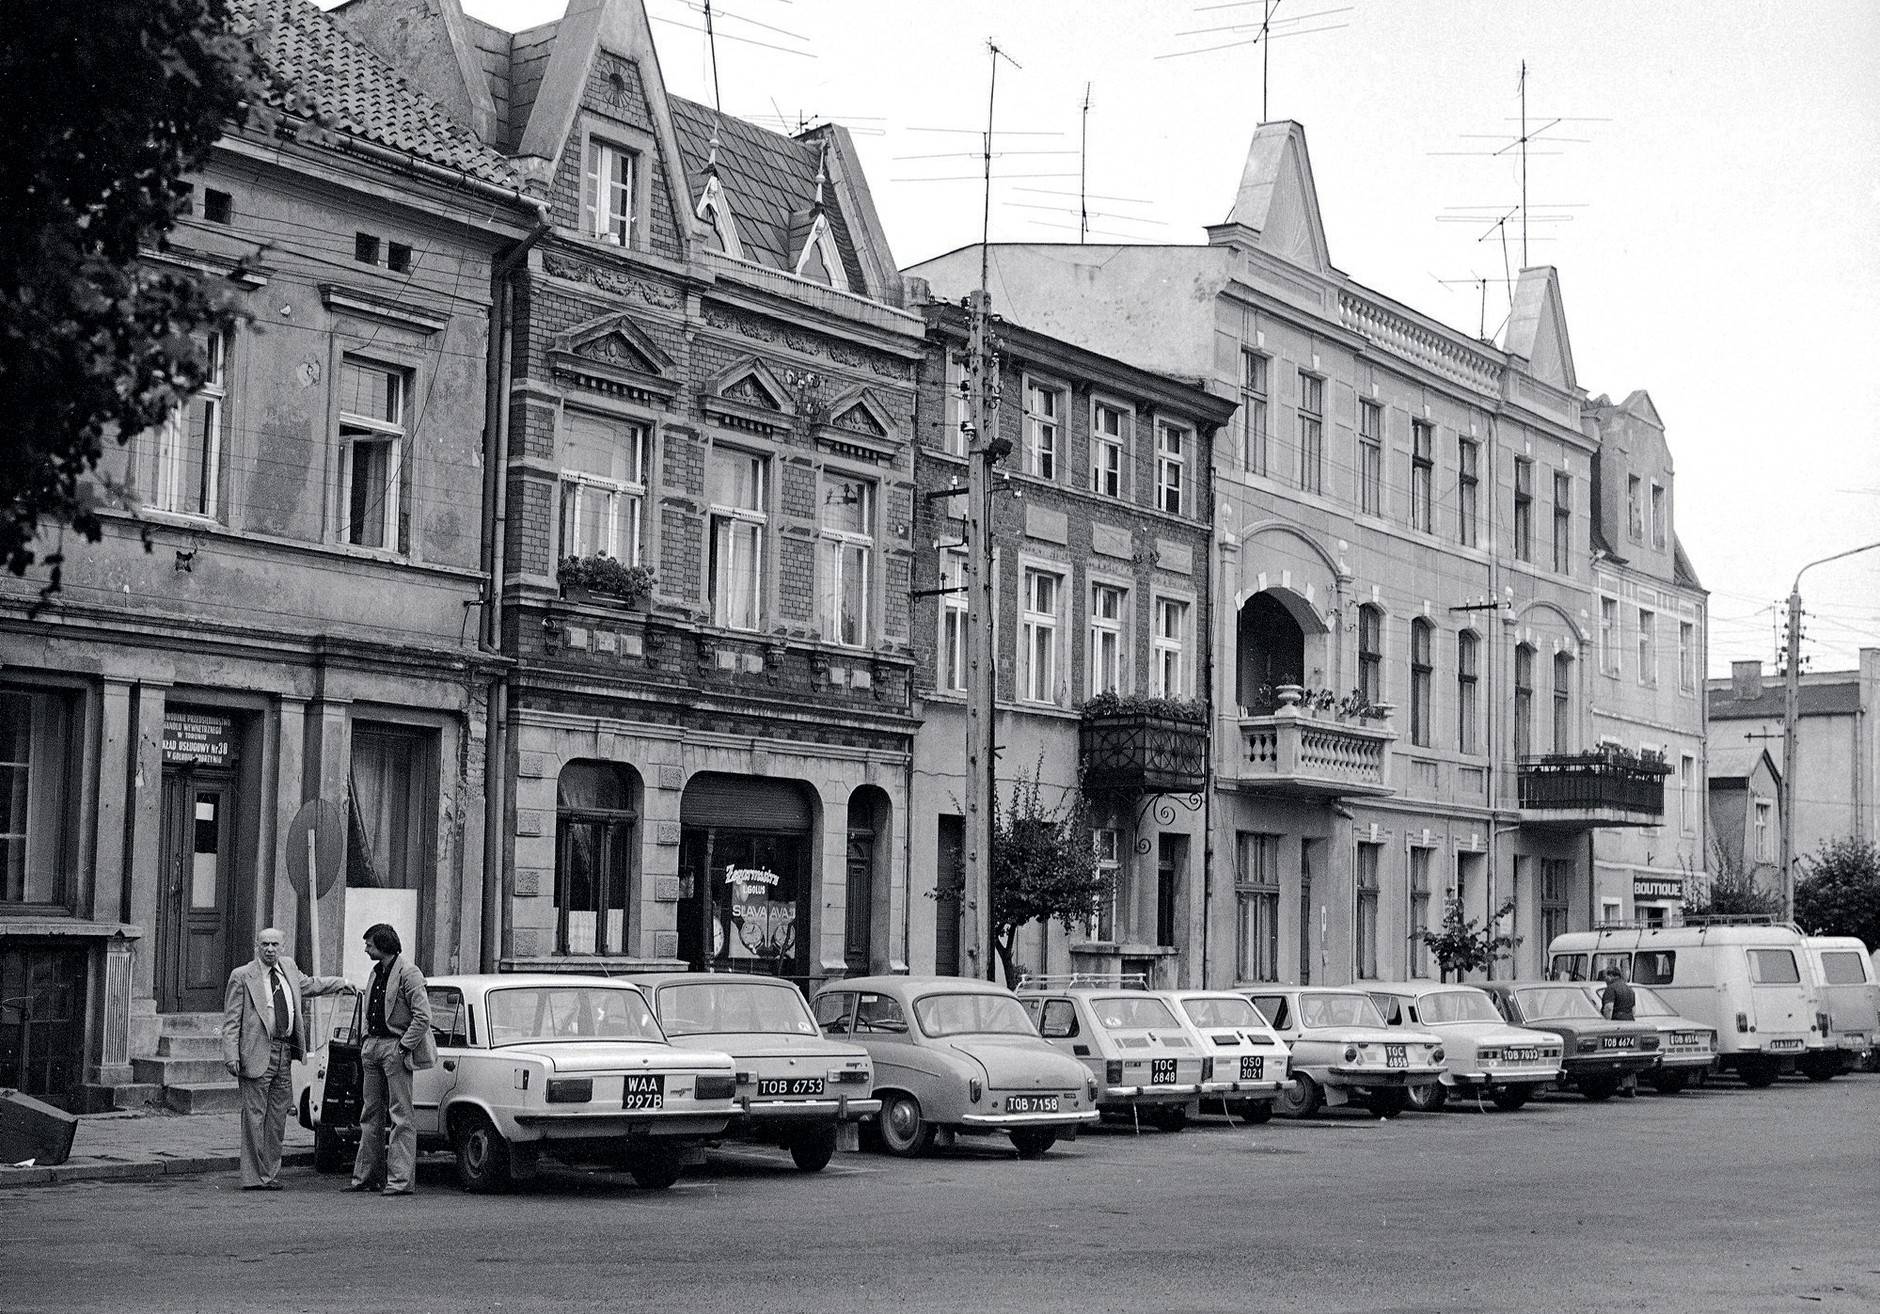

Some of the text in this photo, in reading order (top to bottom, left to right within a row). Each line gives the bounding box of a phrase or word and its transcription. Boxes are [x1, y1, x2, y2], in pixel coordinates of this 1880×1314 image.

[725, 864, 779, 886] Zegarmistrz
[1634, 881, 1681, 896] BOUTIQUE
[732, 904, 768, 918] SLAVA
[1604, 1038, 1617, 1047] TOB
[1387, 1046, 1404, 1056] TOC
[1503, 1049, 1538, 1060] TOB 7033
[1154, 1060, 1174, 1071] TOC
[1242, 1056, 1261, 1067] OSO
[1153, 1071, 1176, 1083] 6848
[1242, 1068, 1262, 1078] 3021
[628, 1077, 658, 1092] WAA
[761, 1080, 823, 1094] TOB 6753
[626, 1094, 662, 1109] 997B
[1009, 1097, 1058, 1111] TOB 7158
